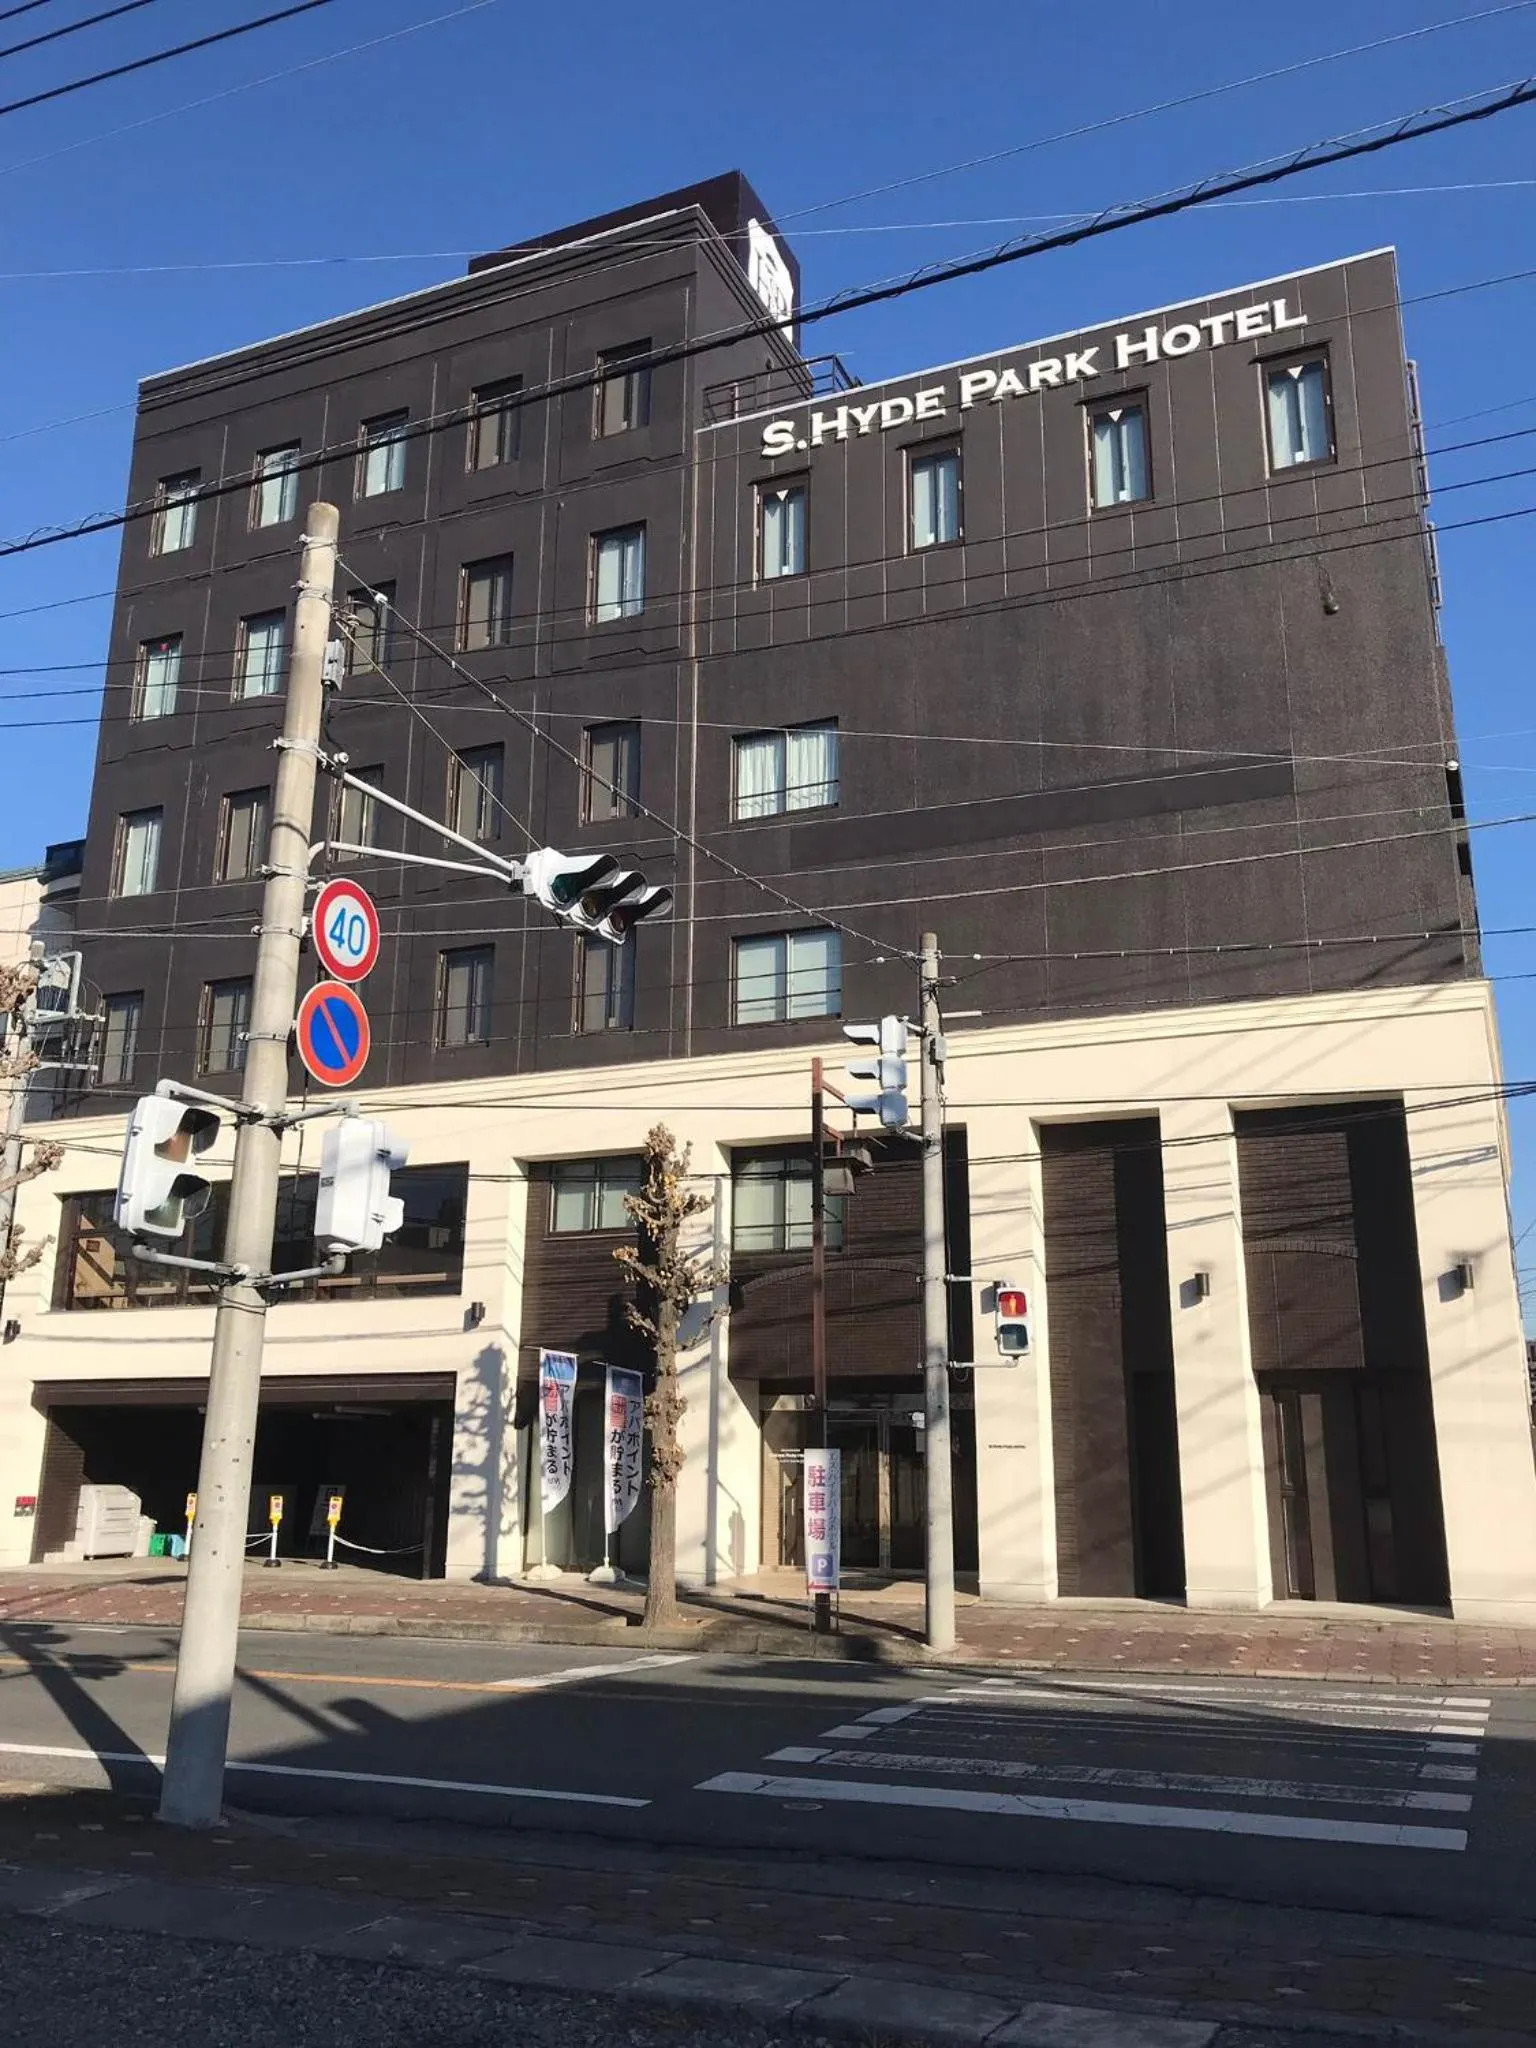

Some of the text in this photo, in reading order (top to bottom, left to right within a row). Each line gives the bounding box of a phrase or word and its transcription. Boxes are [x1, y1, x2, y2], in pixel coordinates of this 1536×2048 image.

[959, 347, 1098, 409] PARK
[1115, 298, 1308, 369] HOTEL
[329, 907, 365, 956] 40
[808, 1465, 825, 1541] 駐車場
[817, 1558, 828, 1573] P
